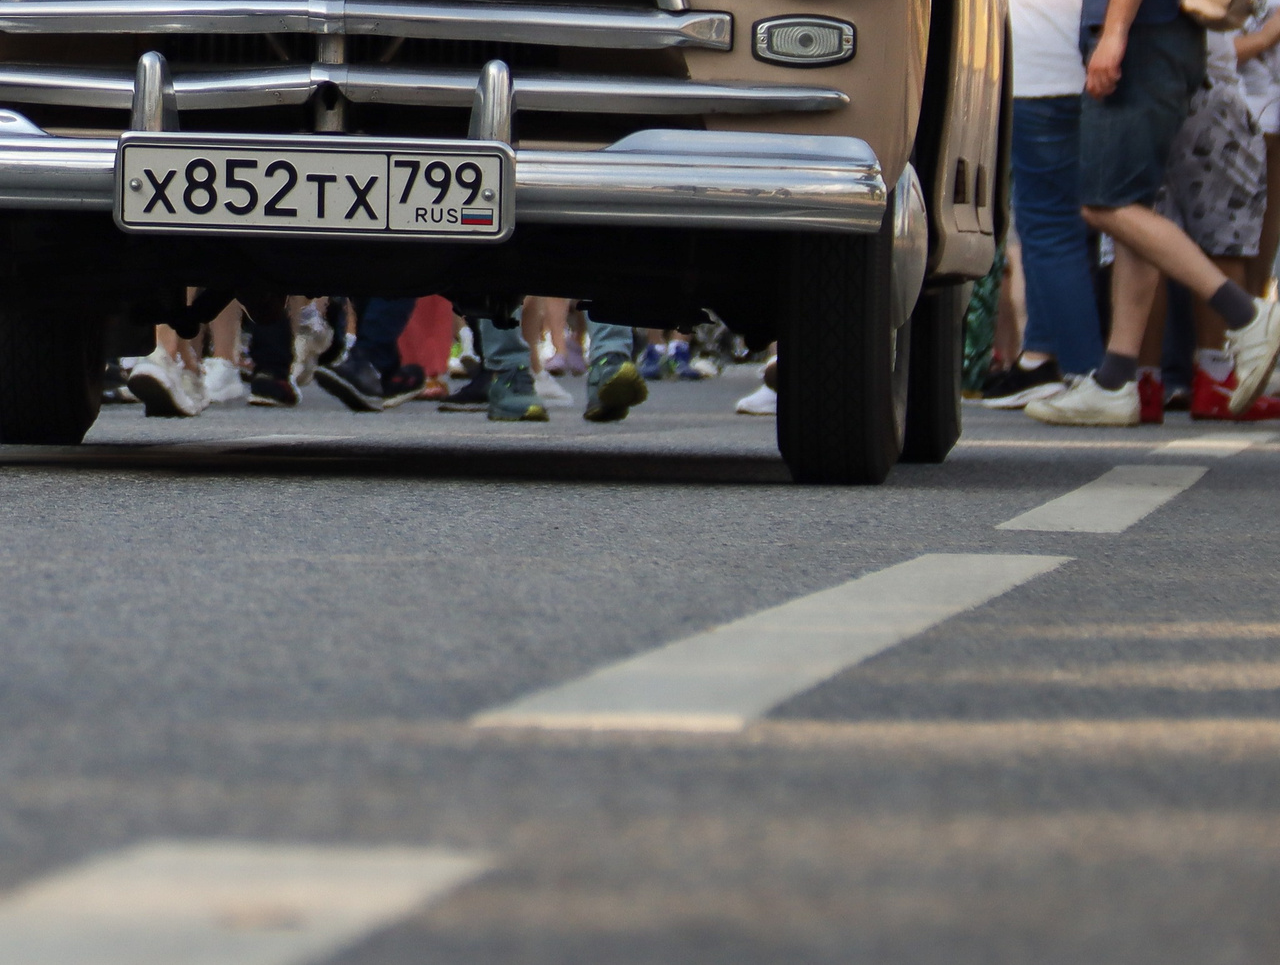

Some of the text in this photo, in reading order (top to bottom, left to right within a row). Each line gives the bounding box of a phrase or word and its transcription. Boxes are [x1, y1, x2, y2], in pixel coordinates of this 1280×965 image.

[142, 157, 483, 221] Х852ТХ 799
[415, 207, 459, 224] RUS
